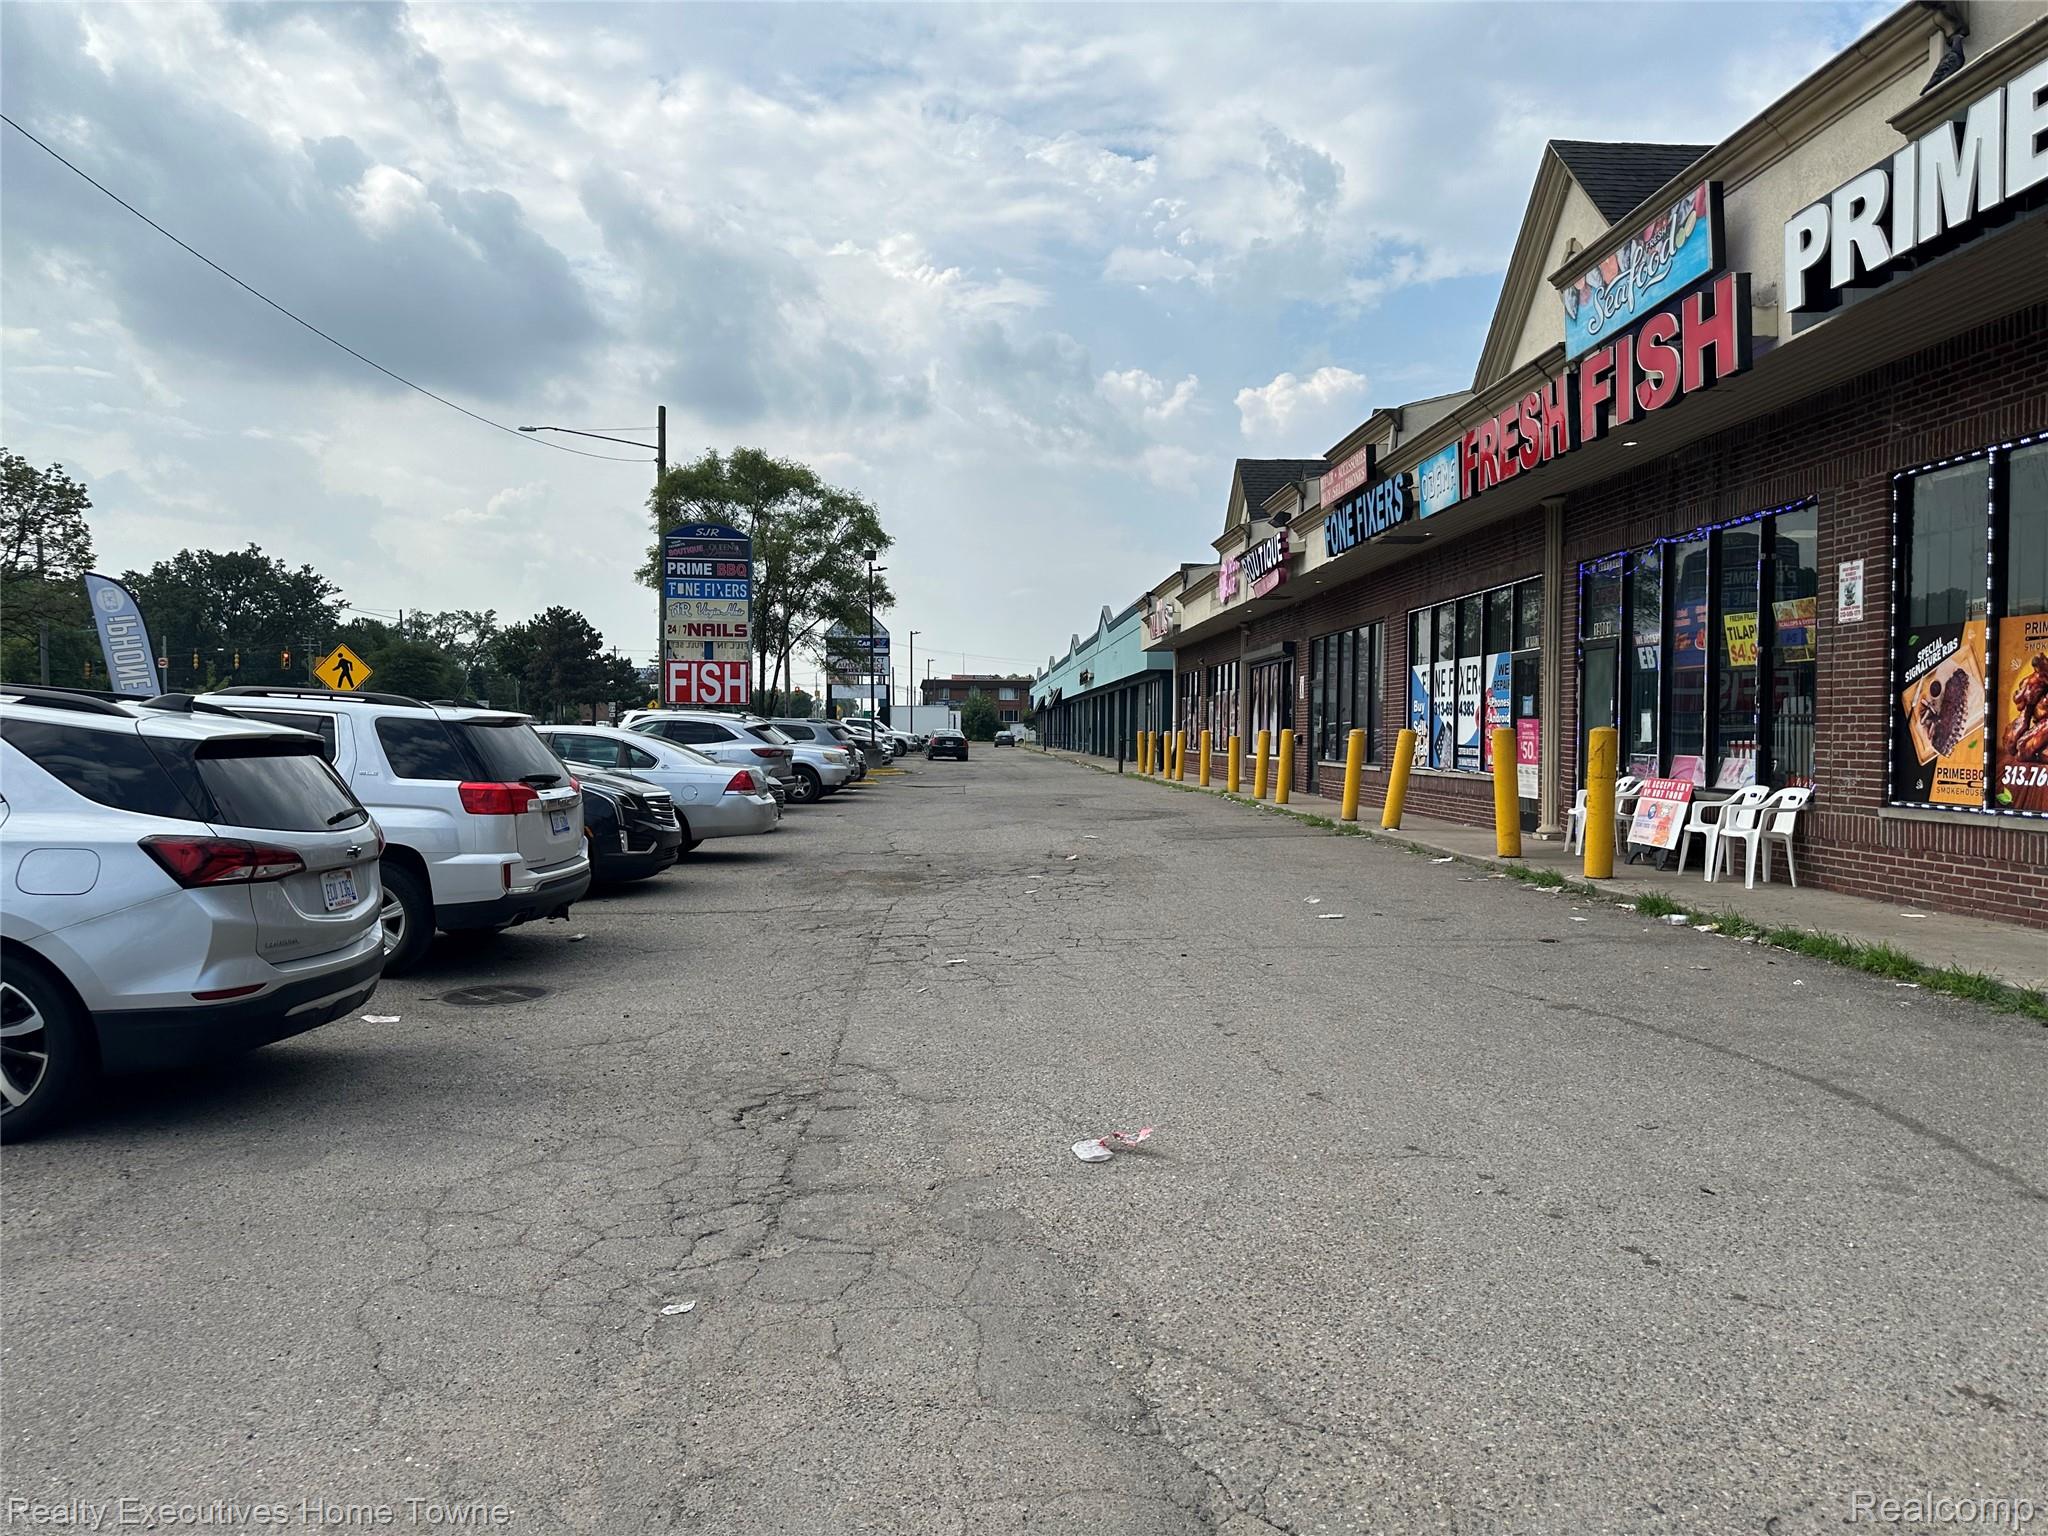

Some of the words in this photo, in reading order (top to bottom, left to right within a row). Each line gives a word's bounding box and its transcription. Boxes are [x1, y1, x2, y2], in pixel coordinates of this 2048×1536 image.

[1784, 59, 2048, 313] PRIME
[1646, 226, 1667, 250] FRESH
[1588, 213, 1677, 335] Seafood
[1462, 371, 1570, 500] FRESH
[1580, 272, 1738, 443] FISH
[1324, 503, 1354, 557] FONE
[1356, 472, 1404, 542] FIXERS
[696, 528, 719, 537] SJR
[668, 545, 705, 557] BOUTIQUE
[1241, 532, 1283, 583] BOUTIQUE
[667, 562, 712, 575] PRIME
[716, 563, 747, 577] BBQ
[688, 623, 748, 637] NAILS
[2025, 621, 2048, 634] PRIM
[1731, 643, 1757, 662] $4.9
[1917, 637, 1944, 662] SPECIAL
[2024, 642, 2048, 651] SMOK
[1498, 664, 1510, 675] WE
[1905, 650, 1942, 682] SIGNATURE
[1943, 638, 1958, 658] RIBS
[669, 663, 747, 703] FISH
[1413, 701, 1425, 716] Buy
[2002, 766, 2048, 787] 313.76
